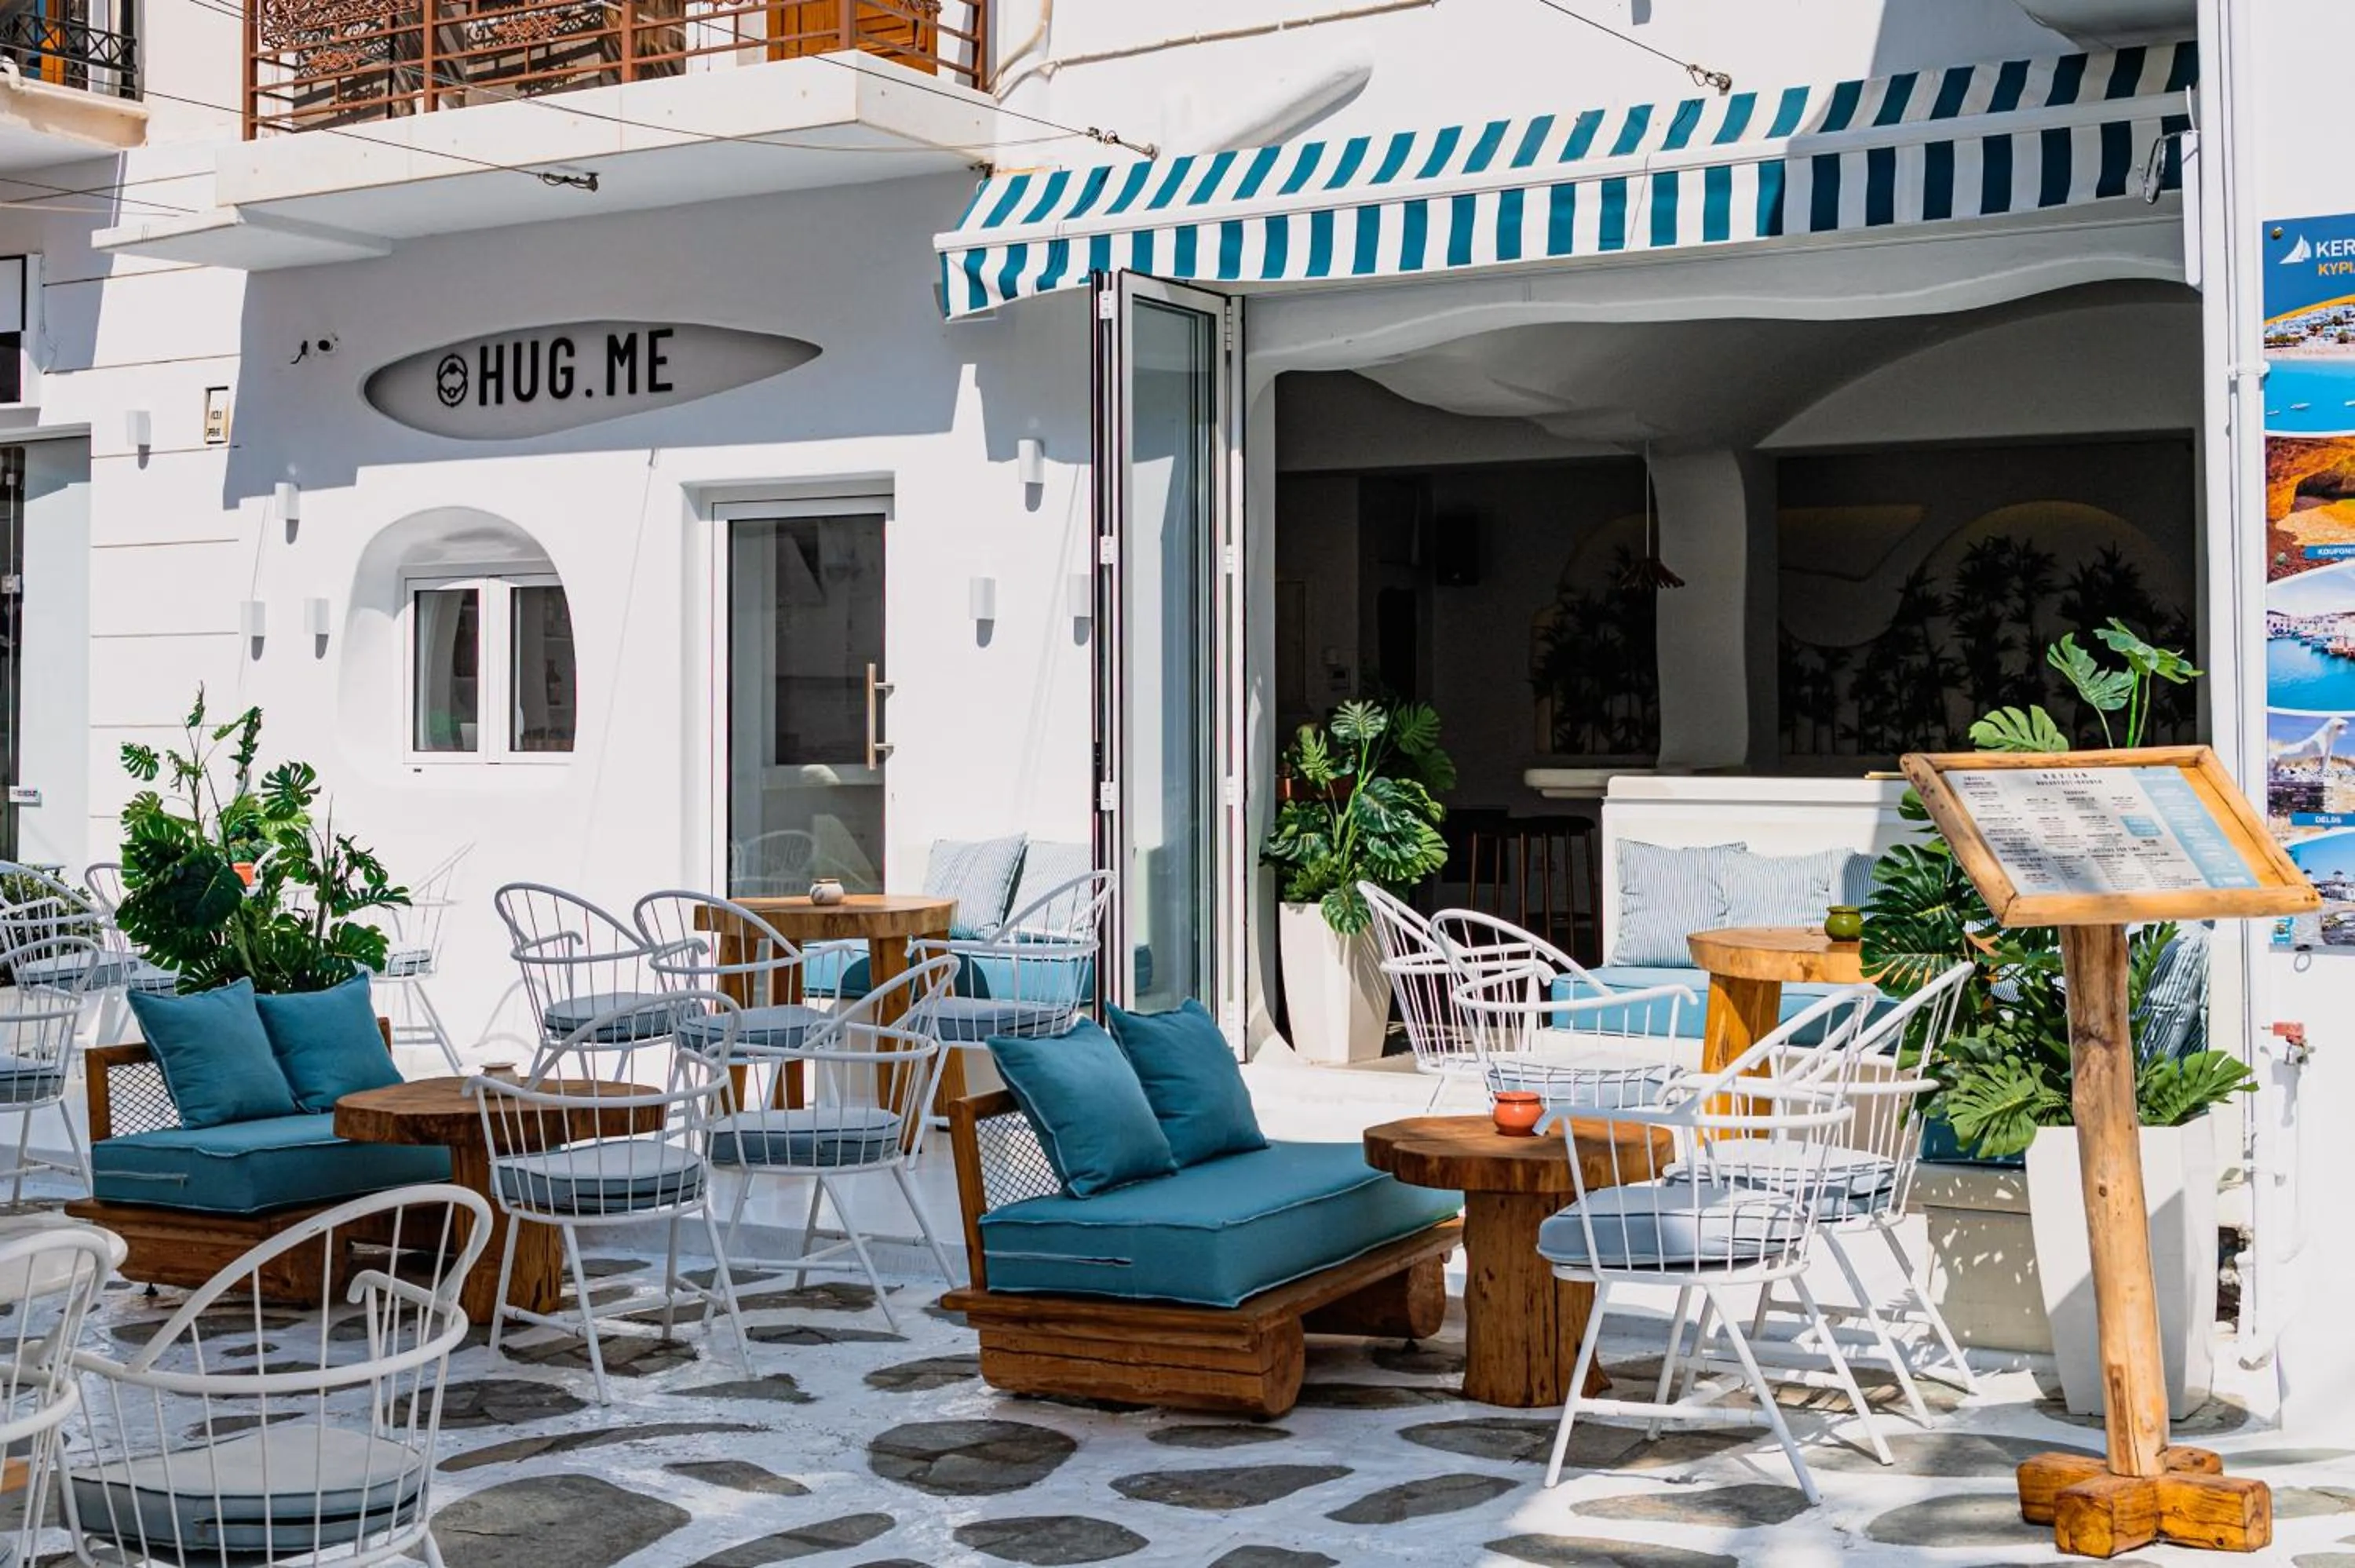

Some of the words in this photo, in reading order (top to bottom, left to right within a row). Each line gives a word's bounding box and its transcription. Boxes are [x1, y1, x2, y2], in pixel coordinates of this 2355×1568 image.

[2317, 239, 2355, 257] KER
[2318, 261, 2355, 276] KYPI
[479, 329, 674, 406] HUG.ME
[2315, 815, 2342, 824] DELOS
